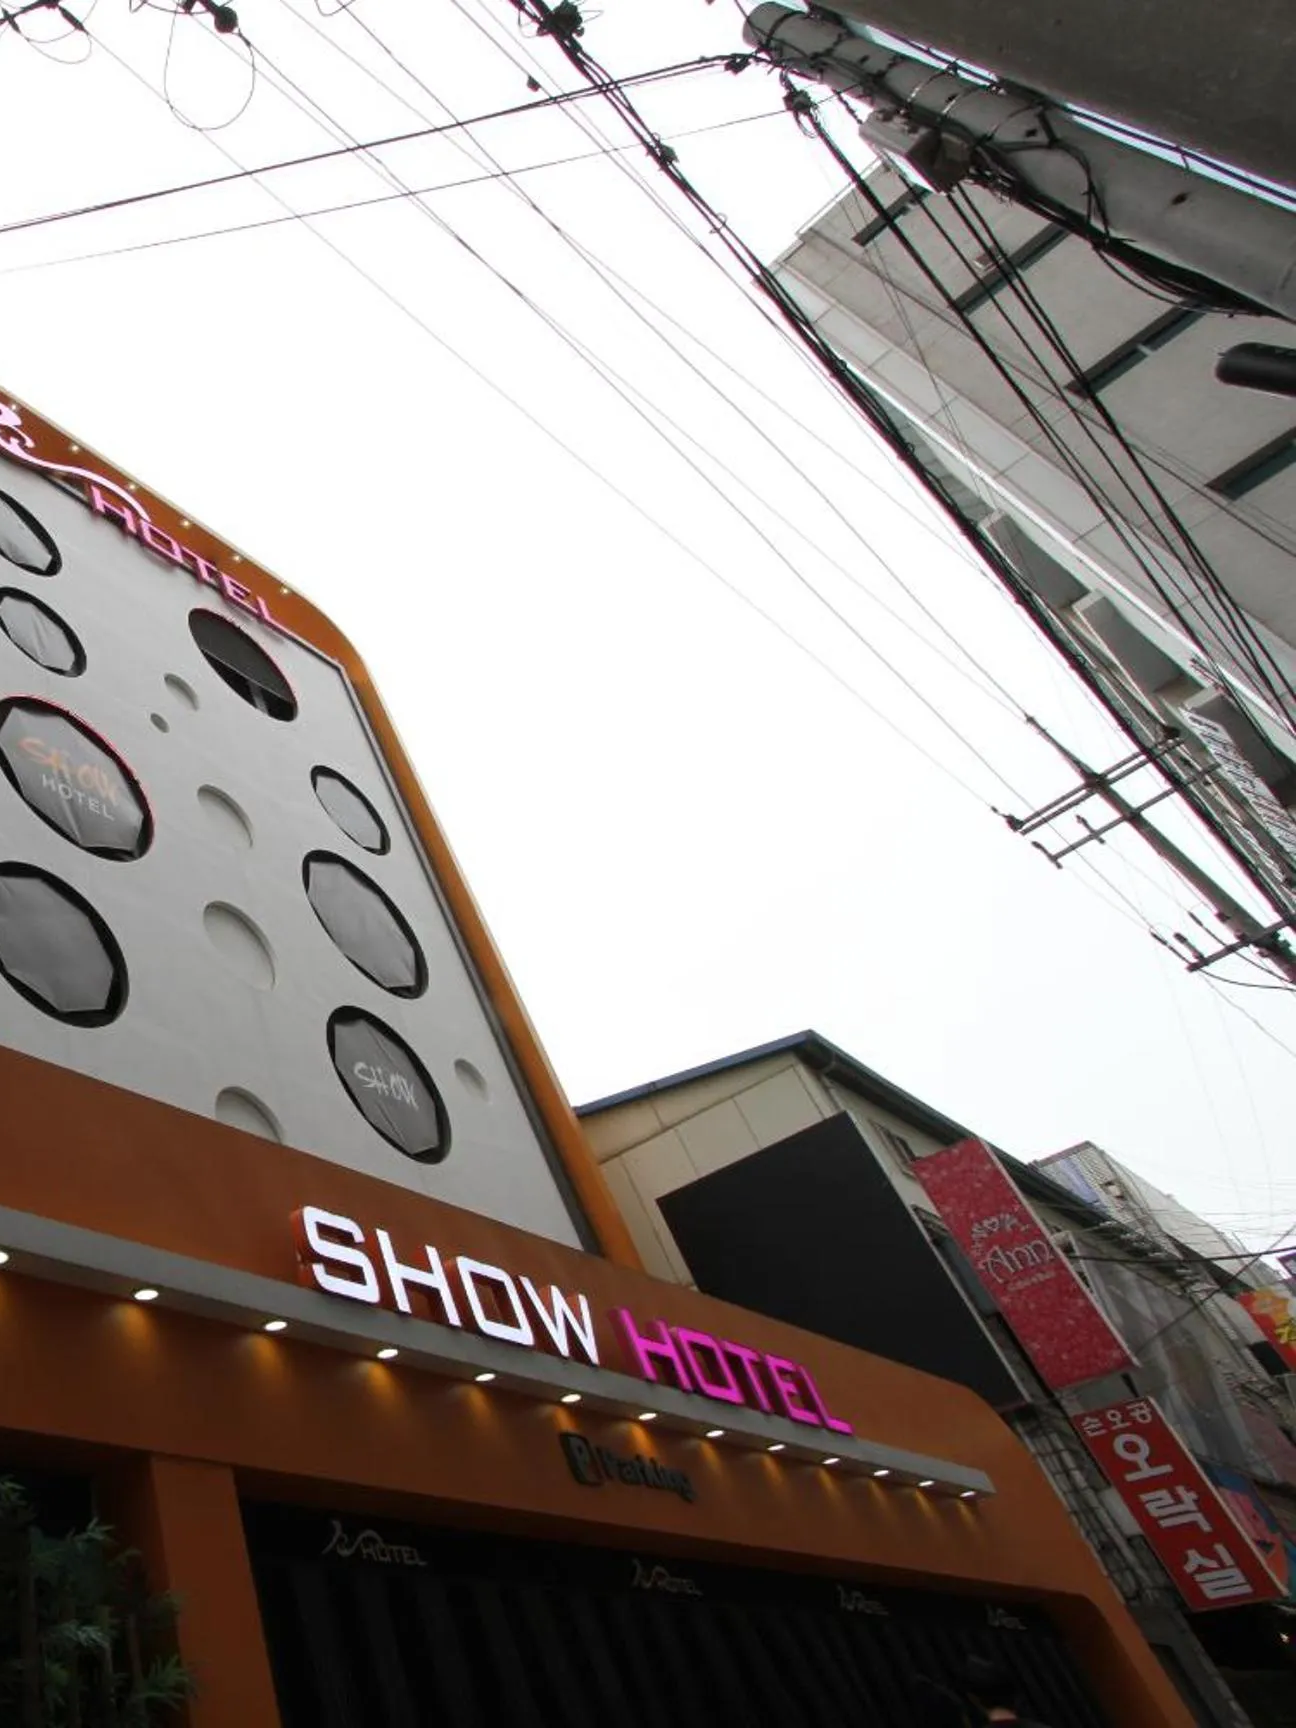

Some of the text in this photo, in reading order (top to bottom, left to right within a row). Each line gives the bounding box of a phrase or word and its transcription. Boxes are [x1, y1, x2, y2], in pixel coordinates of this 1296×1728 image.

[90, 484, 290, 635] HOTEL
[42, 773, 115, 821] HOTEL
[984, 1240, 1050, 1284] Ann
[300, 1205, 853, 1435] SHOW HOTEL
[1082, 1402, 1152, 1437] 손오공
[596, 1447, 696, 1503] Parking
[1113, 1433, 1253, 1599] 오락실
[360, 1541, 429, 1567] HOTEL
